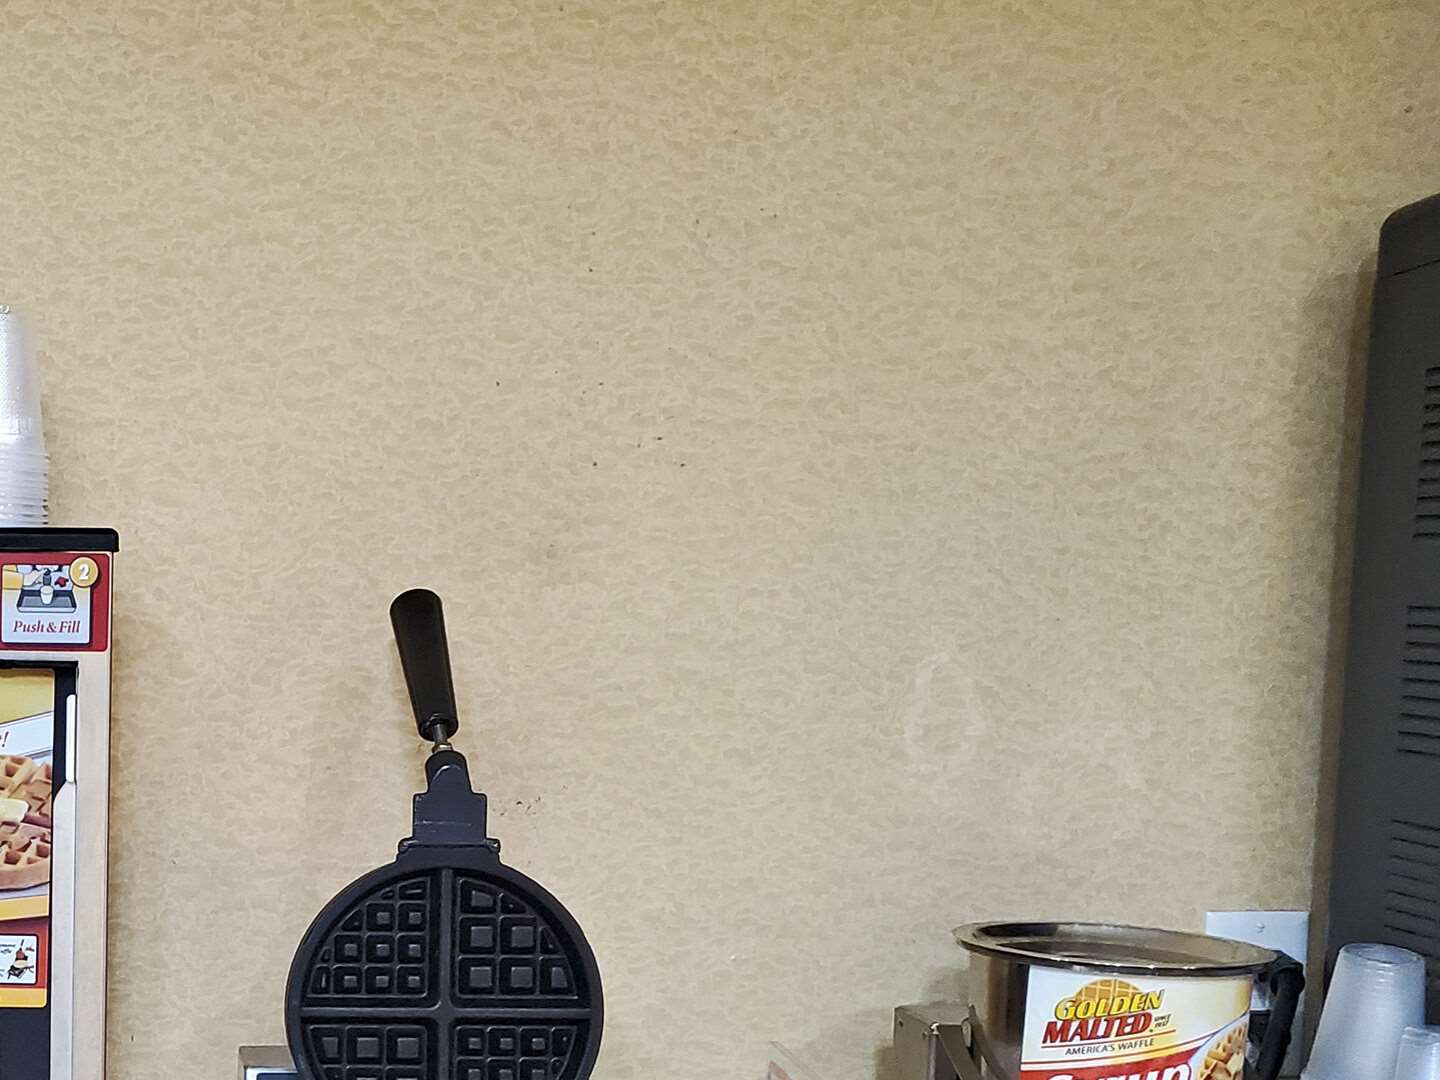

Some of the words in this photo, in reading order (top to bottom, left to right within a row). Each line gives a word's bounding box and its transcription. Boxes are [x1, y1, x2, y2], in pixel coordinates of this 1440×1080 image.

[77, 563, 90, 580] 2
[13, 620, 45, 633] Push
[46, 622, 58, 633] &
[59, 620, 81, 634] Fill
[1054, 988, 1166, 1022] GOLDEN
[1041, 1012, 1153, 1044] MALTED
[1065, 1043, 1116, 1056] AMERICA'S
[1118, 1037, 1156, 1051] WAFFLE
